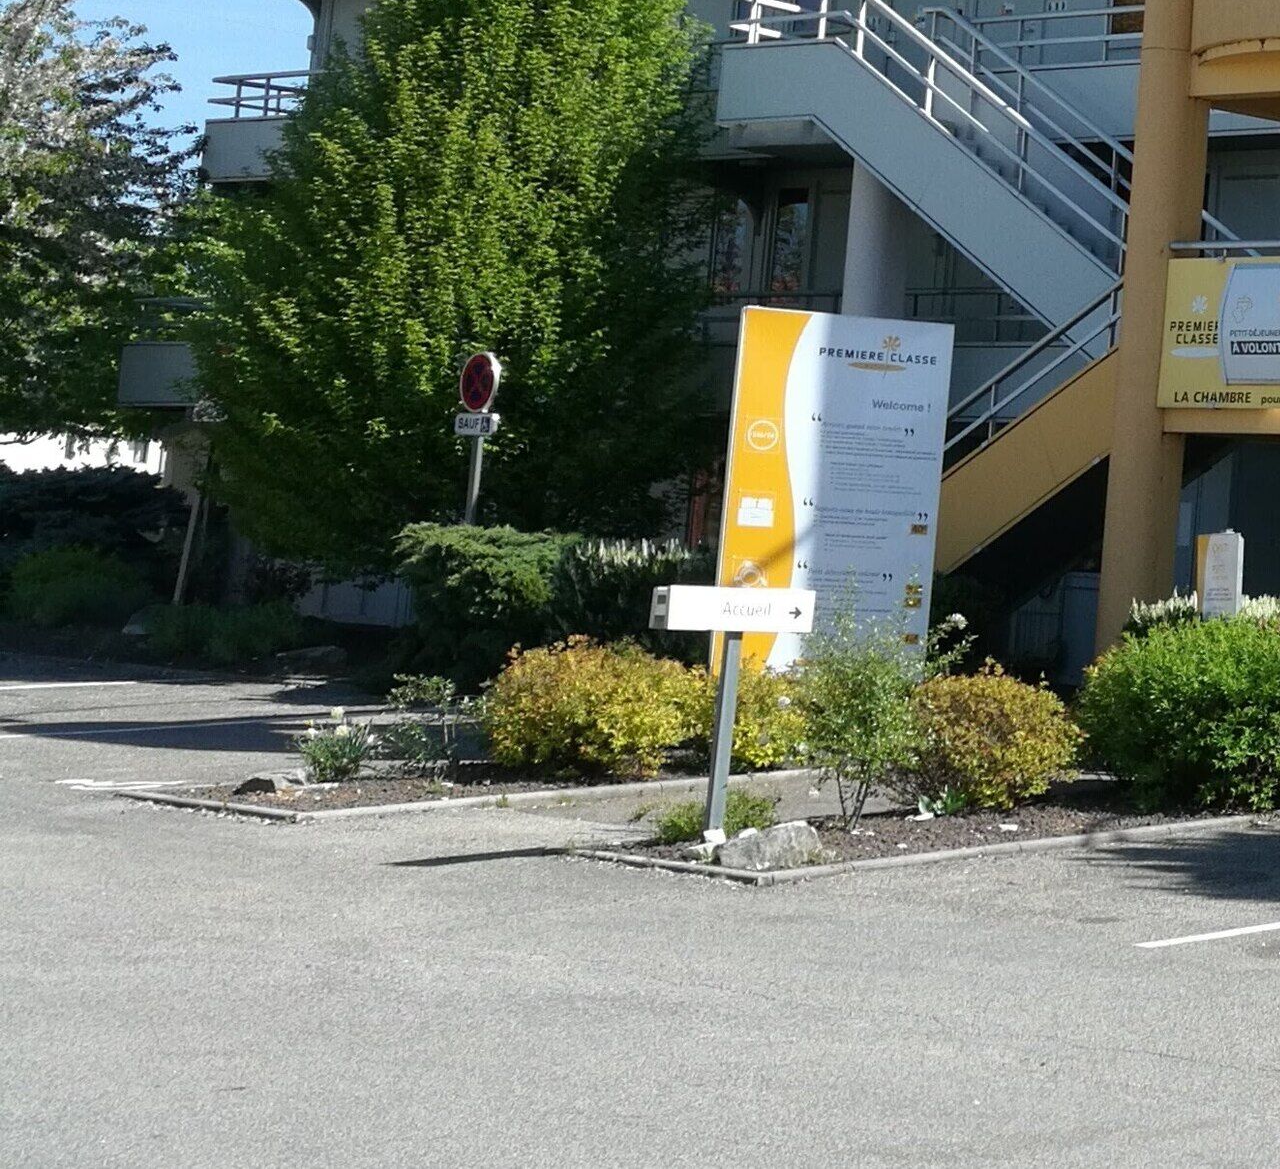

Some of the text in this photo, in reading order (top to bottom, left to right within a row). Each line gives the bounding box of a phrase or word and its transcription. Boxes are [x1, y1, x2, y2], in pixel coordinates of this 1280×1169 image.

[1175, 333, 1218, 344] CLASSE
[818, 346, 937, 366] PREMIERE CLASSE
[1174, 391, 1189, 403] LA
[1193, 391, 1252, 404] CHAMBRE
[871, 398, 924, 412] Welcome
[458, 416, 480, 429] SAUF
[722, 601, 772, 617] Accueil
